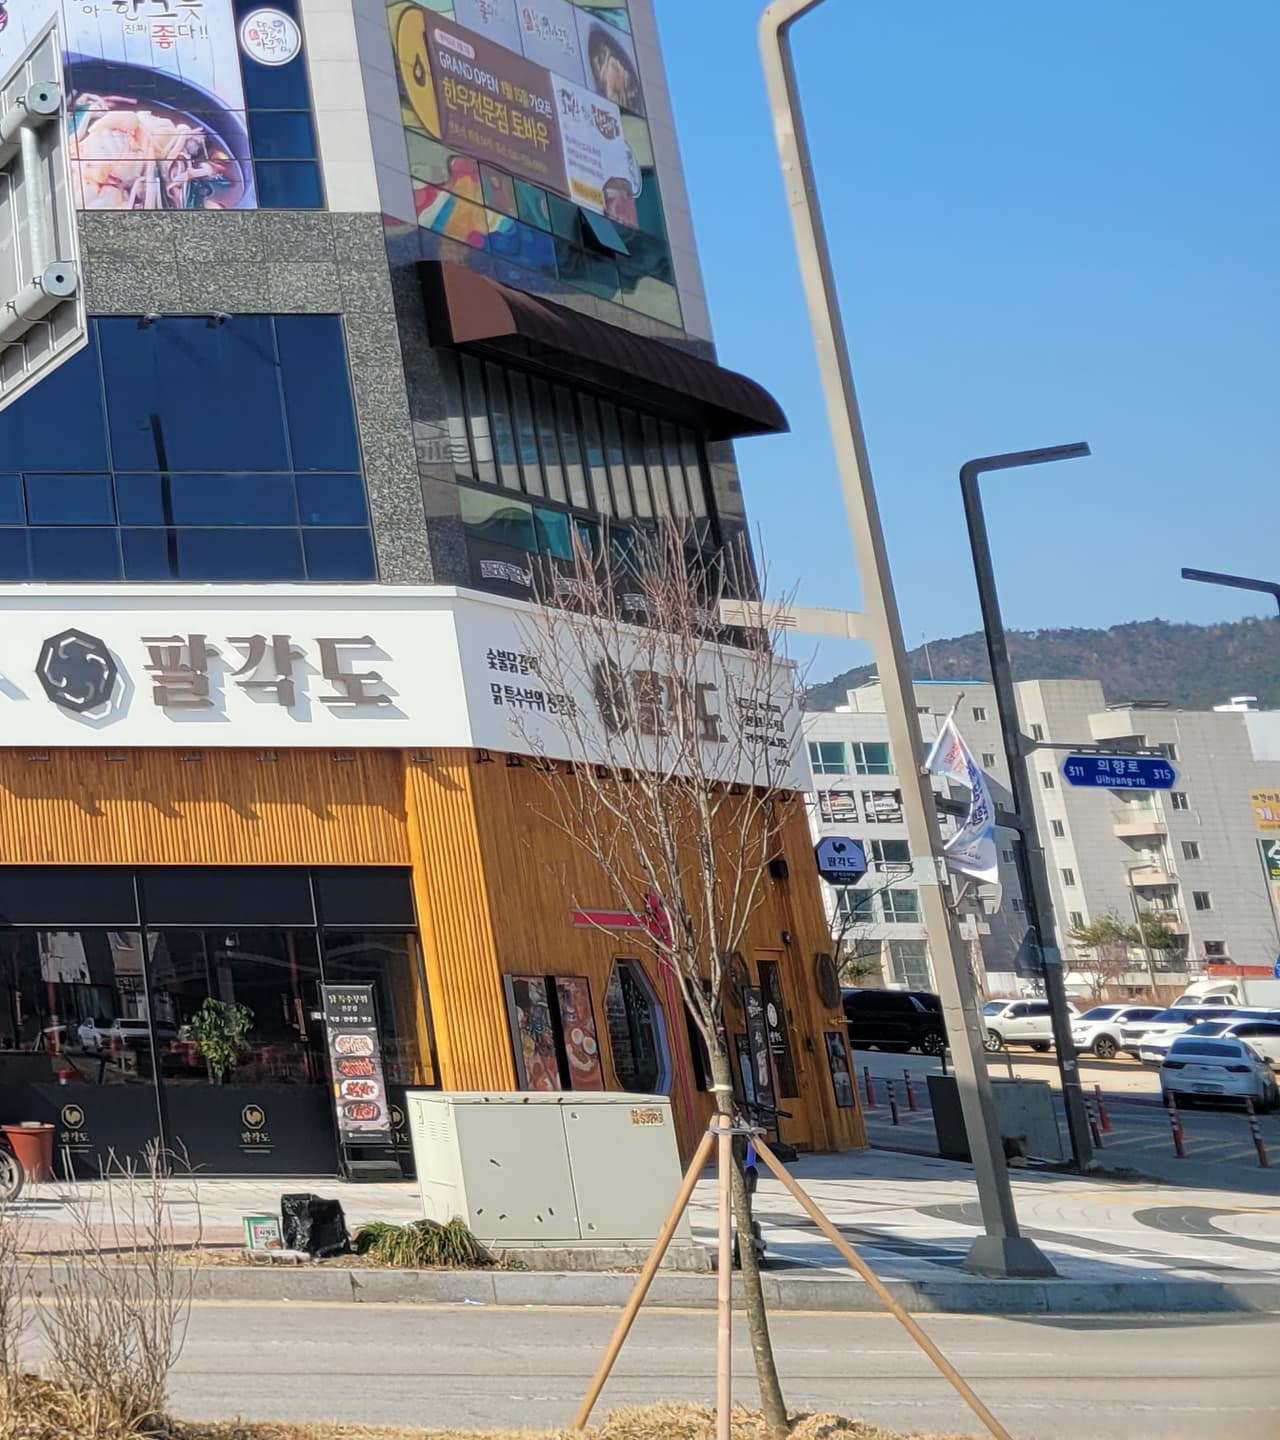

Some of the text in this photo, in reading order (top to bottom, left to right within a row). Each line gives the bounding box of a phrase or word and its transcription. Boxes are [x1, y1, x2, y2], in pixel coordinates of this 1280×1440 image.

[438, 50, 474, 81] GRAND
[473, 67, 500, 95] OPEN
[442, 77, 509, 135] 한우전문점
[510, 111, 550, 152] 토바우
[141, 634, 393, 709] 팔각도
[1068, 766, 1085, 777] 311
[1097, 759, 1141, 775] 의향로
[1152, 768, 1171, 780] 315
[826, 856, 857, 868] 팔각도
